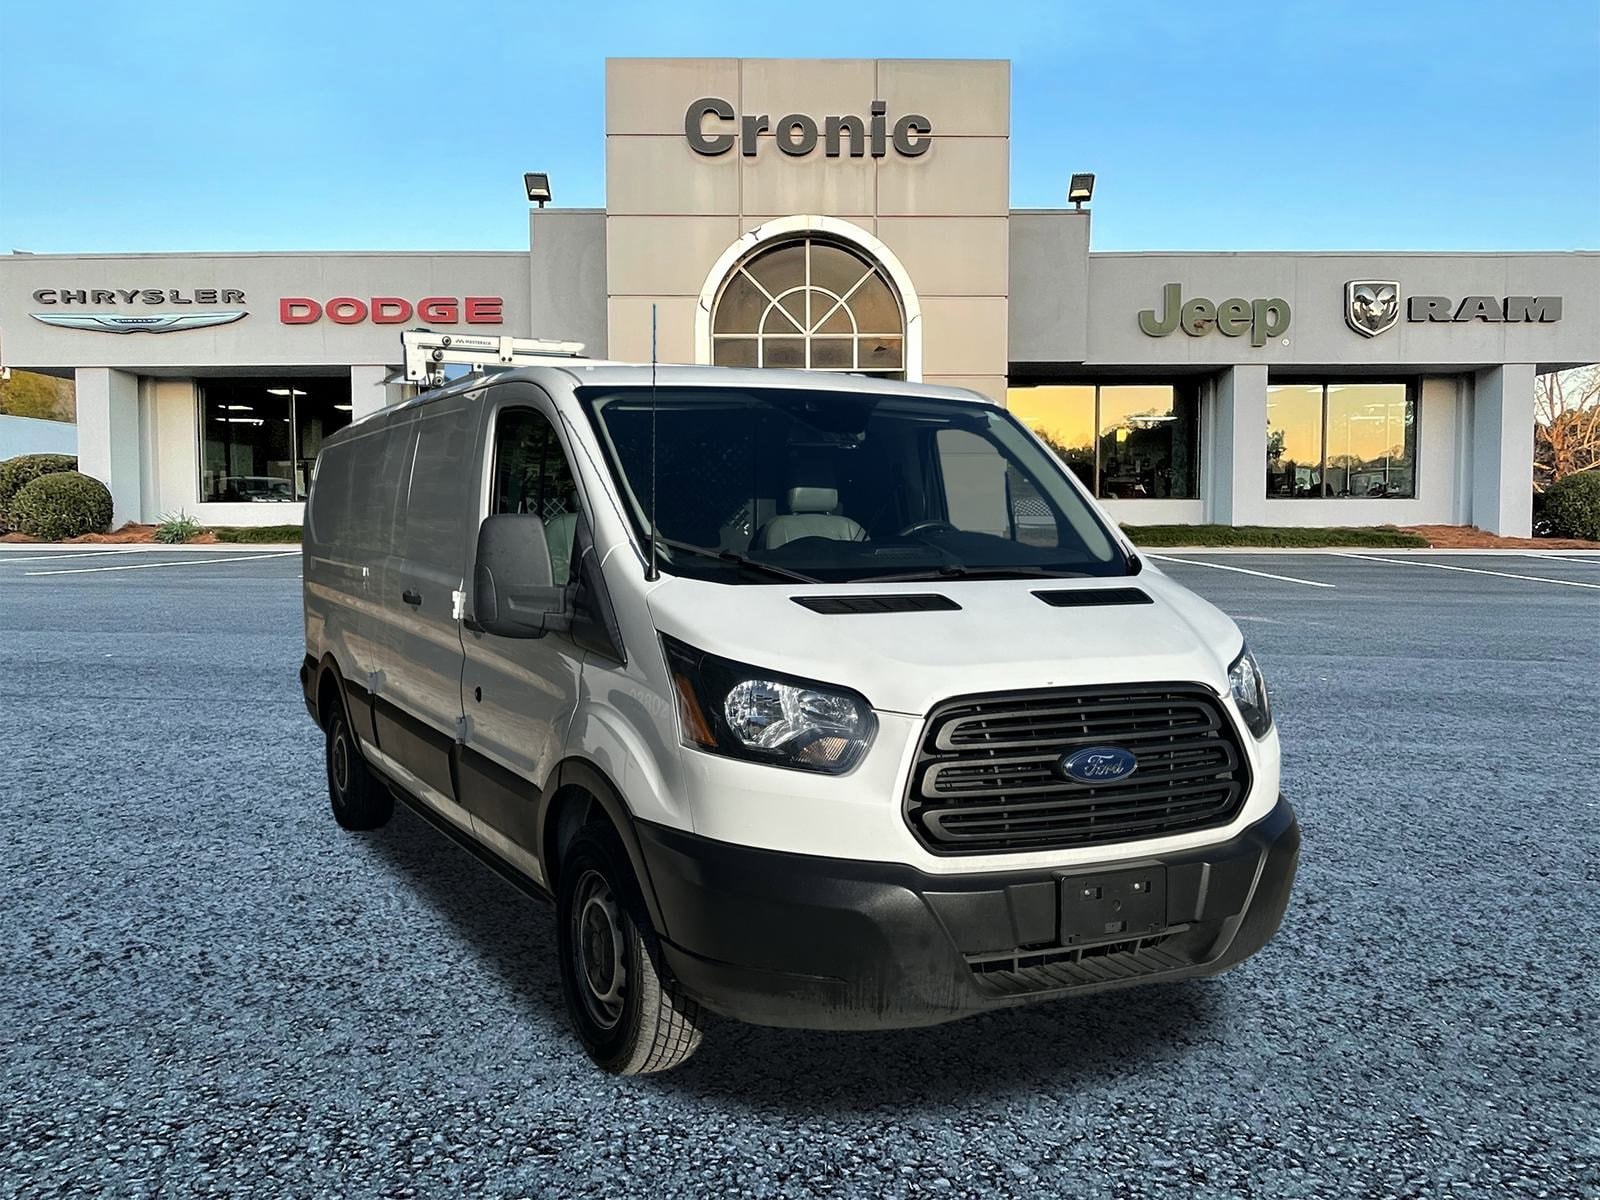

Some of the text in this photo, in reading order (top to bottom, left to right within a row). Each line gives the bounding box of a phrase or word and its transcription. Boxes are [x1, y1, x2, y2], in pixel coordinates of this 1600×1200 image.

[685, 97, 932, 157] Cronic
[33, 288, 247, 305] CHRYSLER
[1408, 296, 1563, 322] RAM
[279, 297, 503, 324] DODGE
[1138, 283, 1291, 346] Jeep
[1084, 754, 1124, 776] Ford
